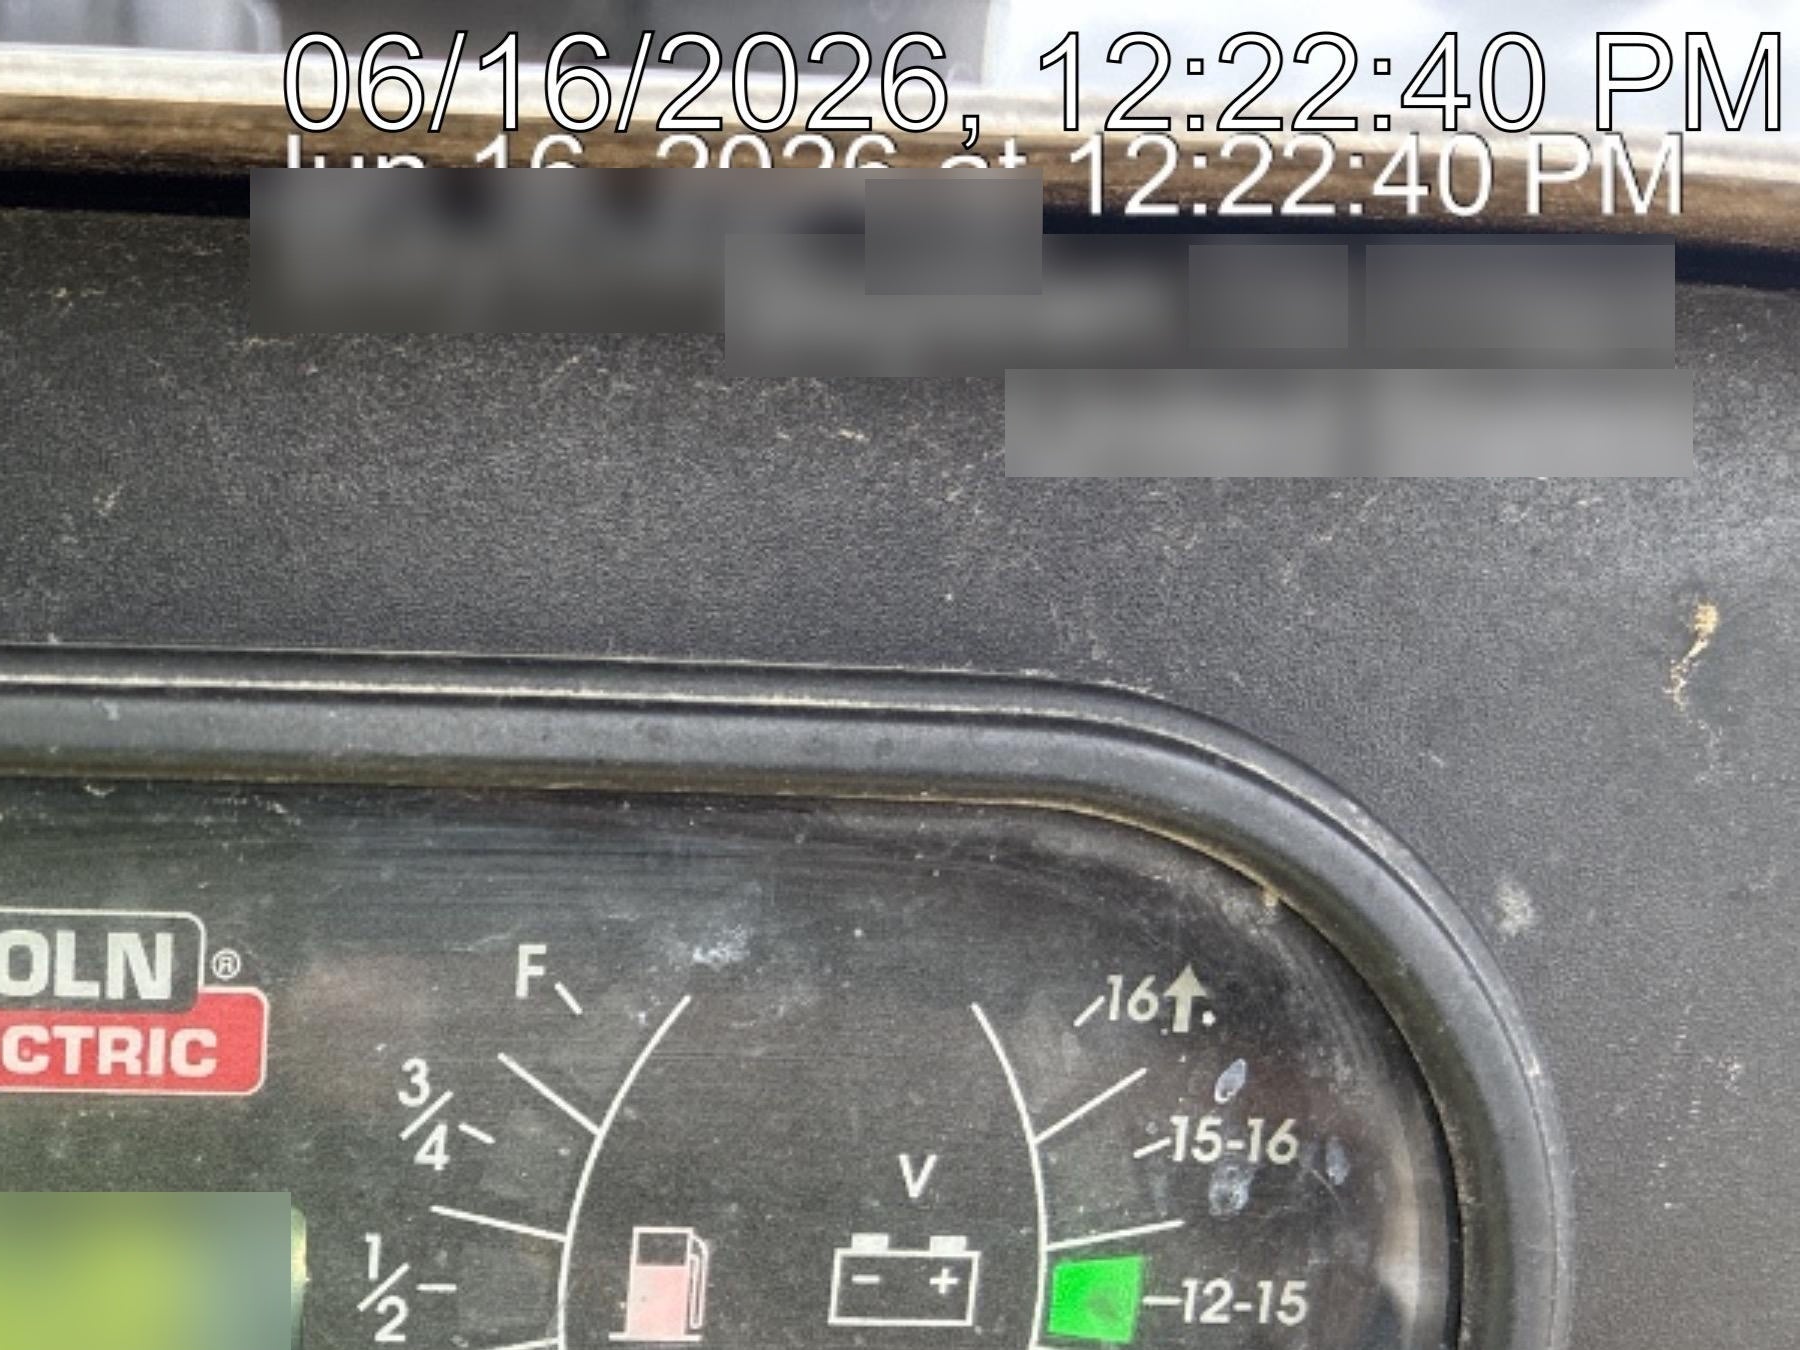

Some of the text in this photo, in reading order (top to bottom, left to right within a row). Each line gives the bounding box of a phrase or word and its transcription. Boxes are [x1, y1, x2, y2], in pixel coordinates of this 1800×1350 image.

[515, 943, 548, 998] F
[1106, 973, 1160, 1023] 16
[1169, 1115, 1299, 1166] 15-16
[898, 1154, 938, 1199] V
[1181, 1280, 1308, 1326] 12-15
